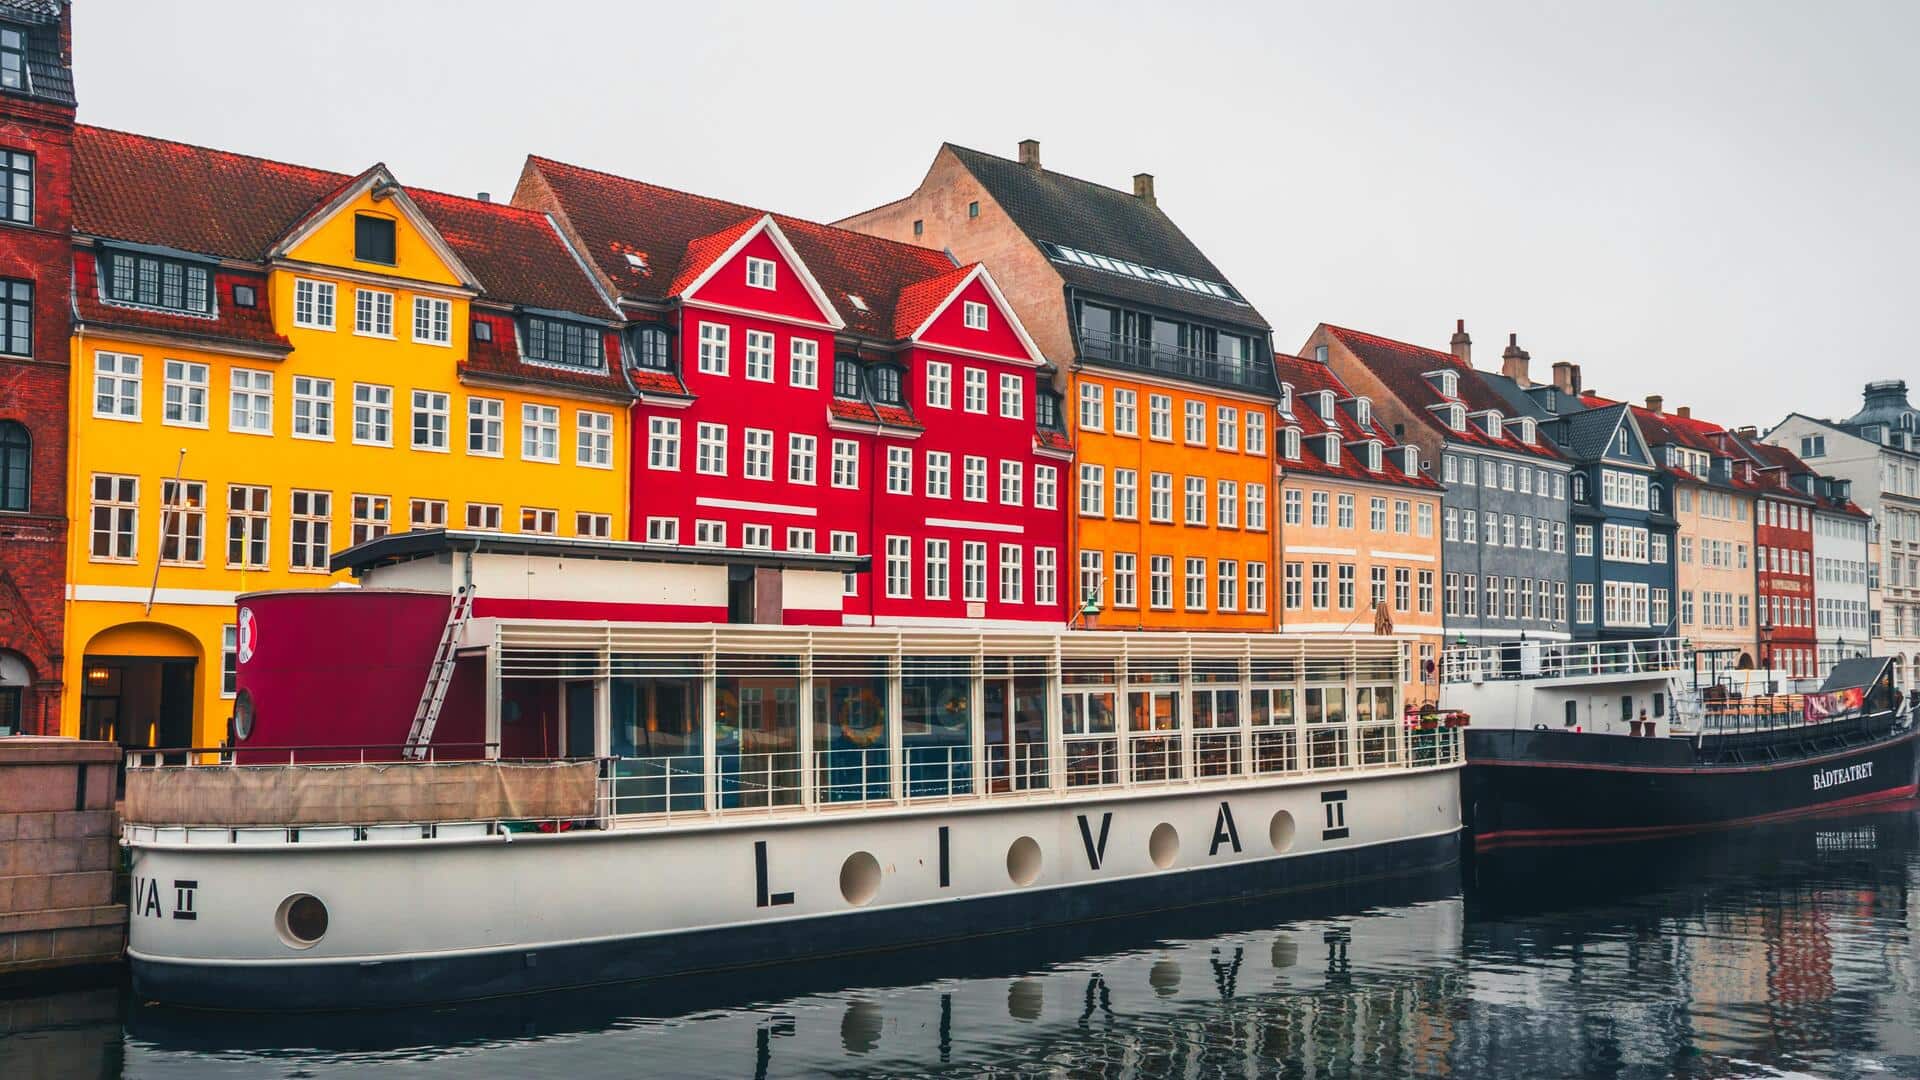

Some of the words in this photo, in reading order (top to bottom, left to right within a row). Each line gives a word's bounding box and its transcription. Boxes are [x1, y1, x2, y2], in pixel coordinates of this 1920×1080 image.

[1813, 762, 1872, 790] BÅDTEATRET
[1320, 789, 1349, 841] II
[173, 879, 198, 920] II
